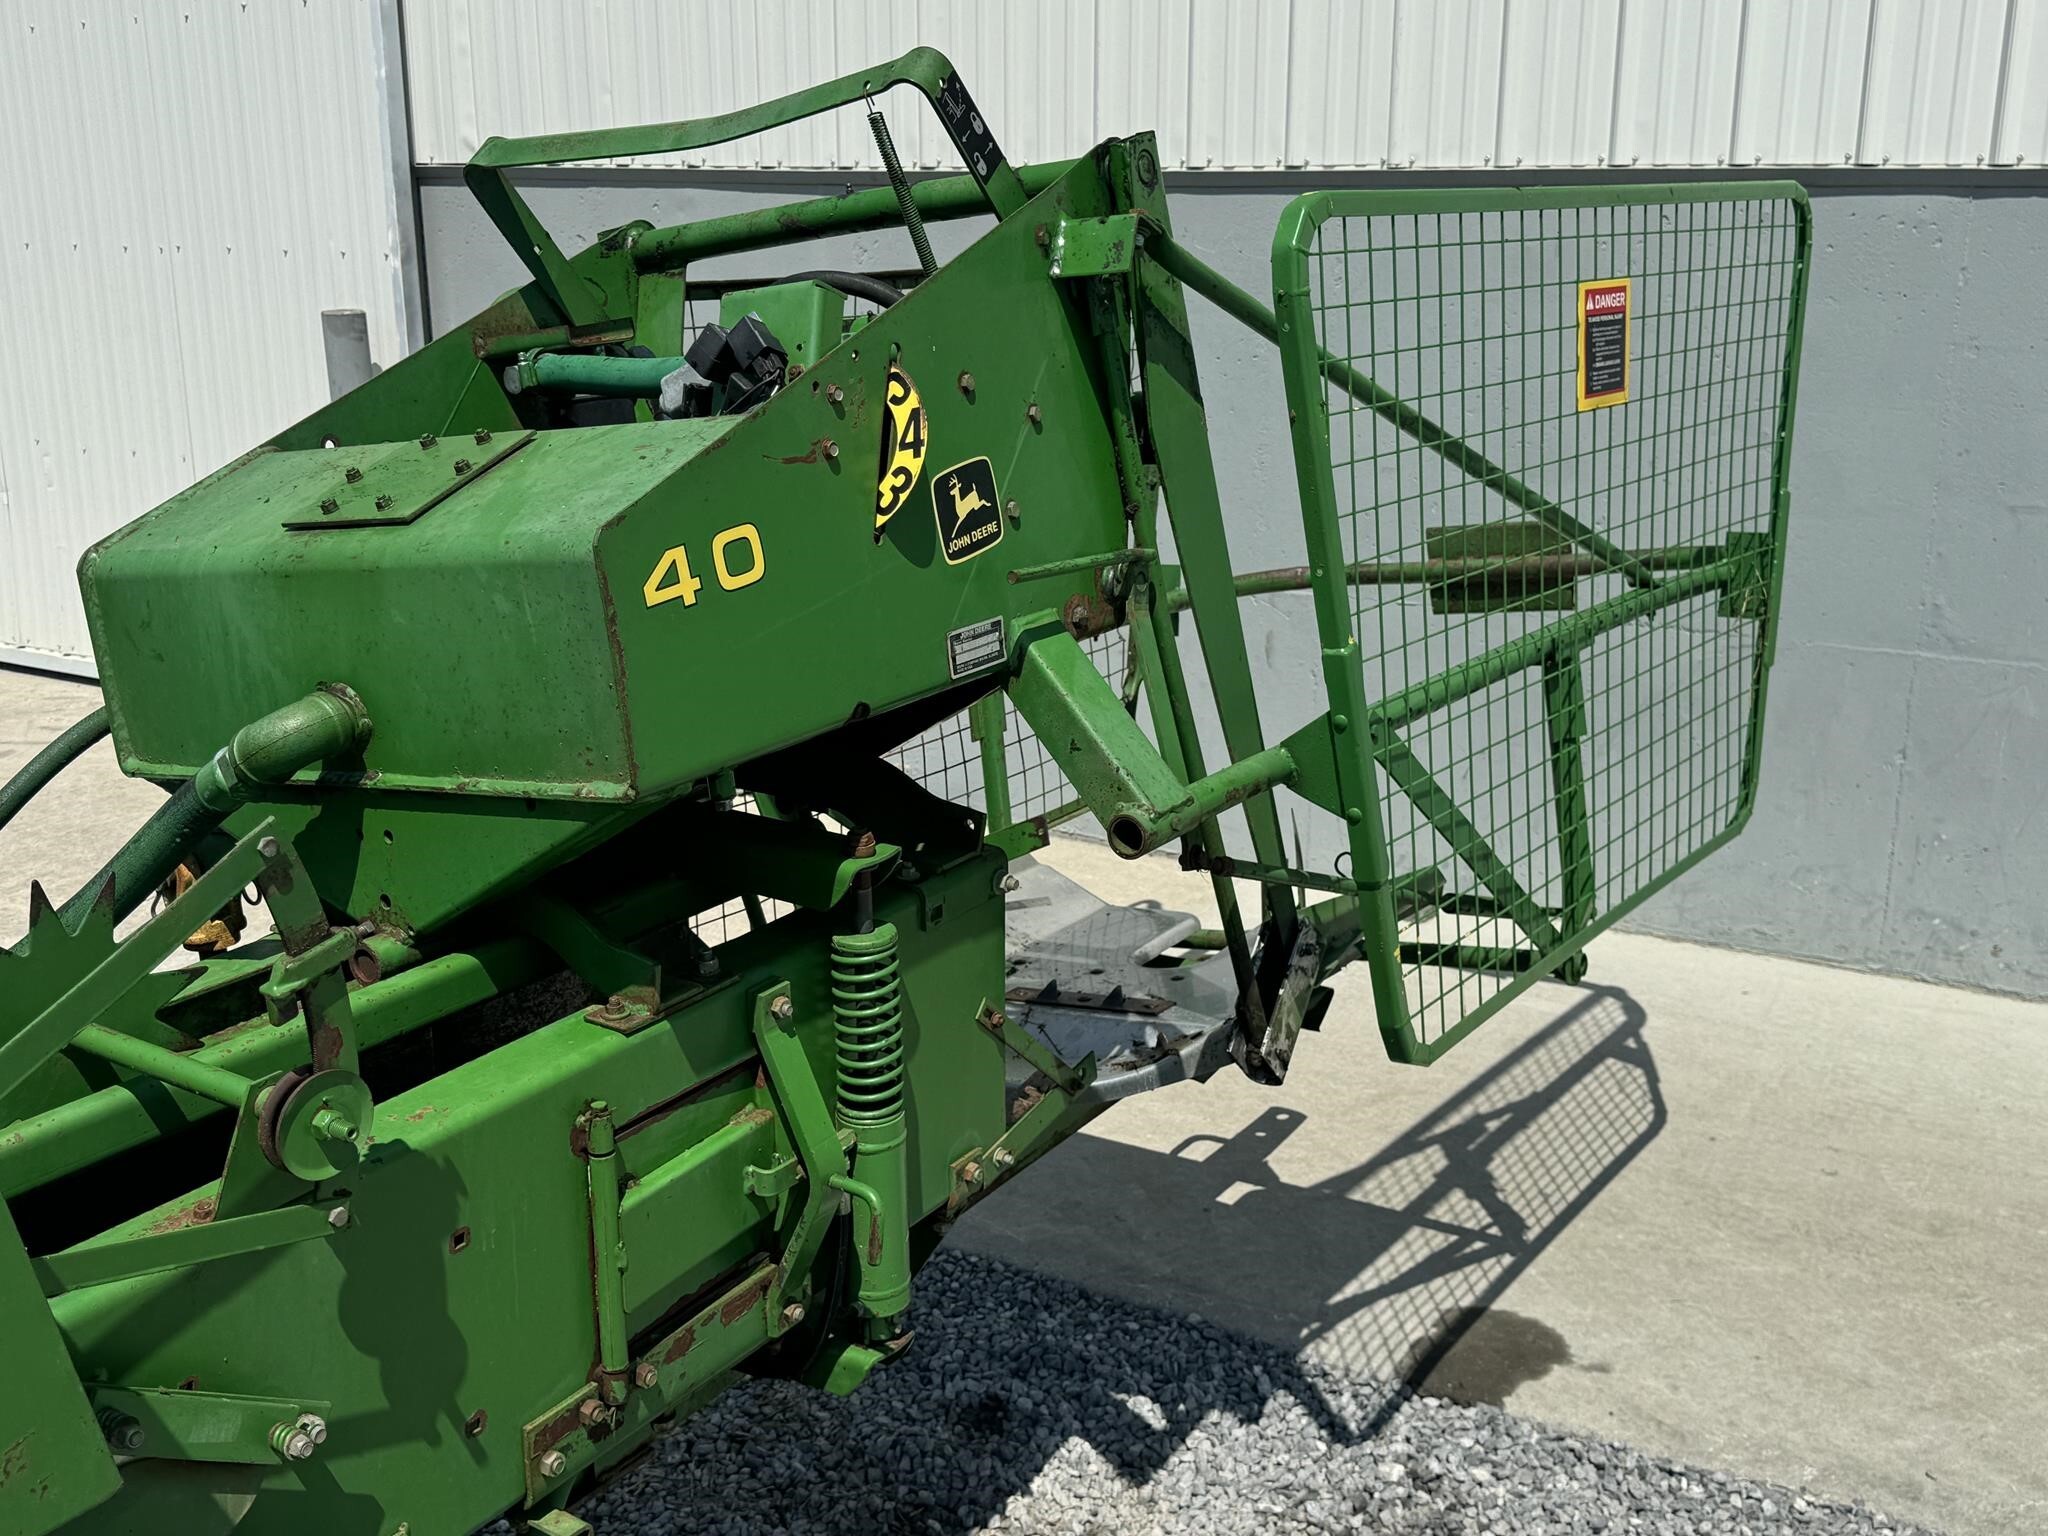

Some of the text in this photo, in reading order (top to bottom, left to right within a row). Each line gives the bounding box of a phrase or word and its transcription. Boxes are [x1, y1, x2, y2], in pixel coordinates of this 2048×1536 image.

[1595, 292, 1625, 309] DANGER
[898, 406, 925, 459] 4
[877, 465, 913, 517] 3
[948, 521, 999, 554] JOHN DEERE
[643, 522, 766, 609] 40
[975, 623, 992, 634] DEERE
